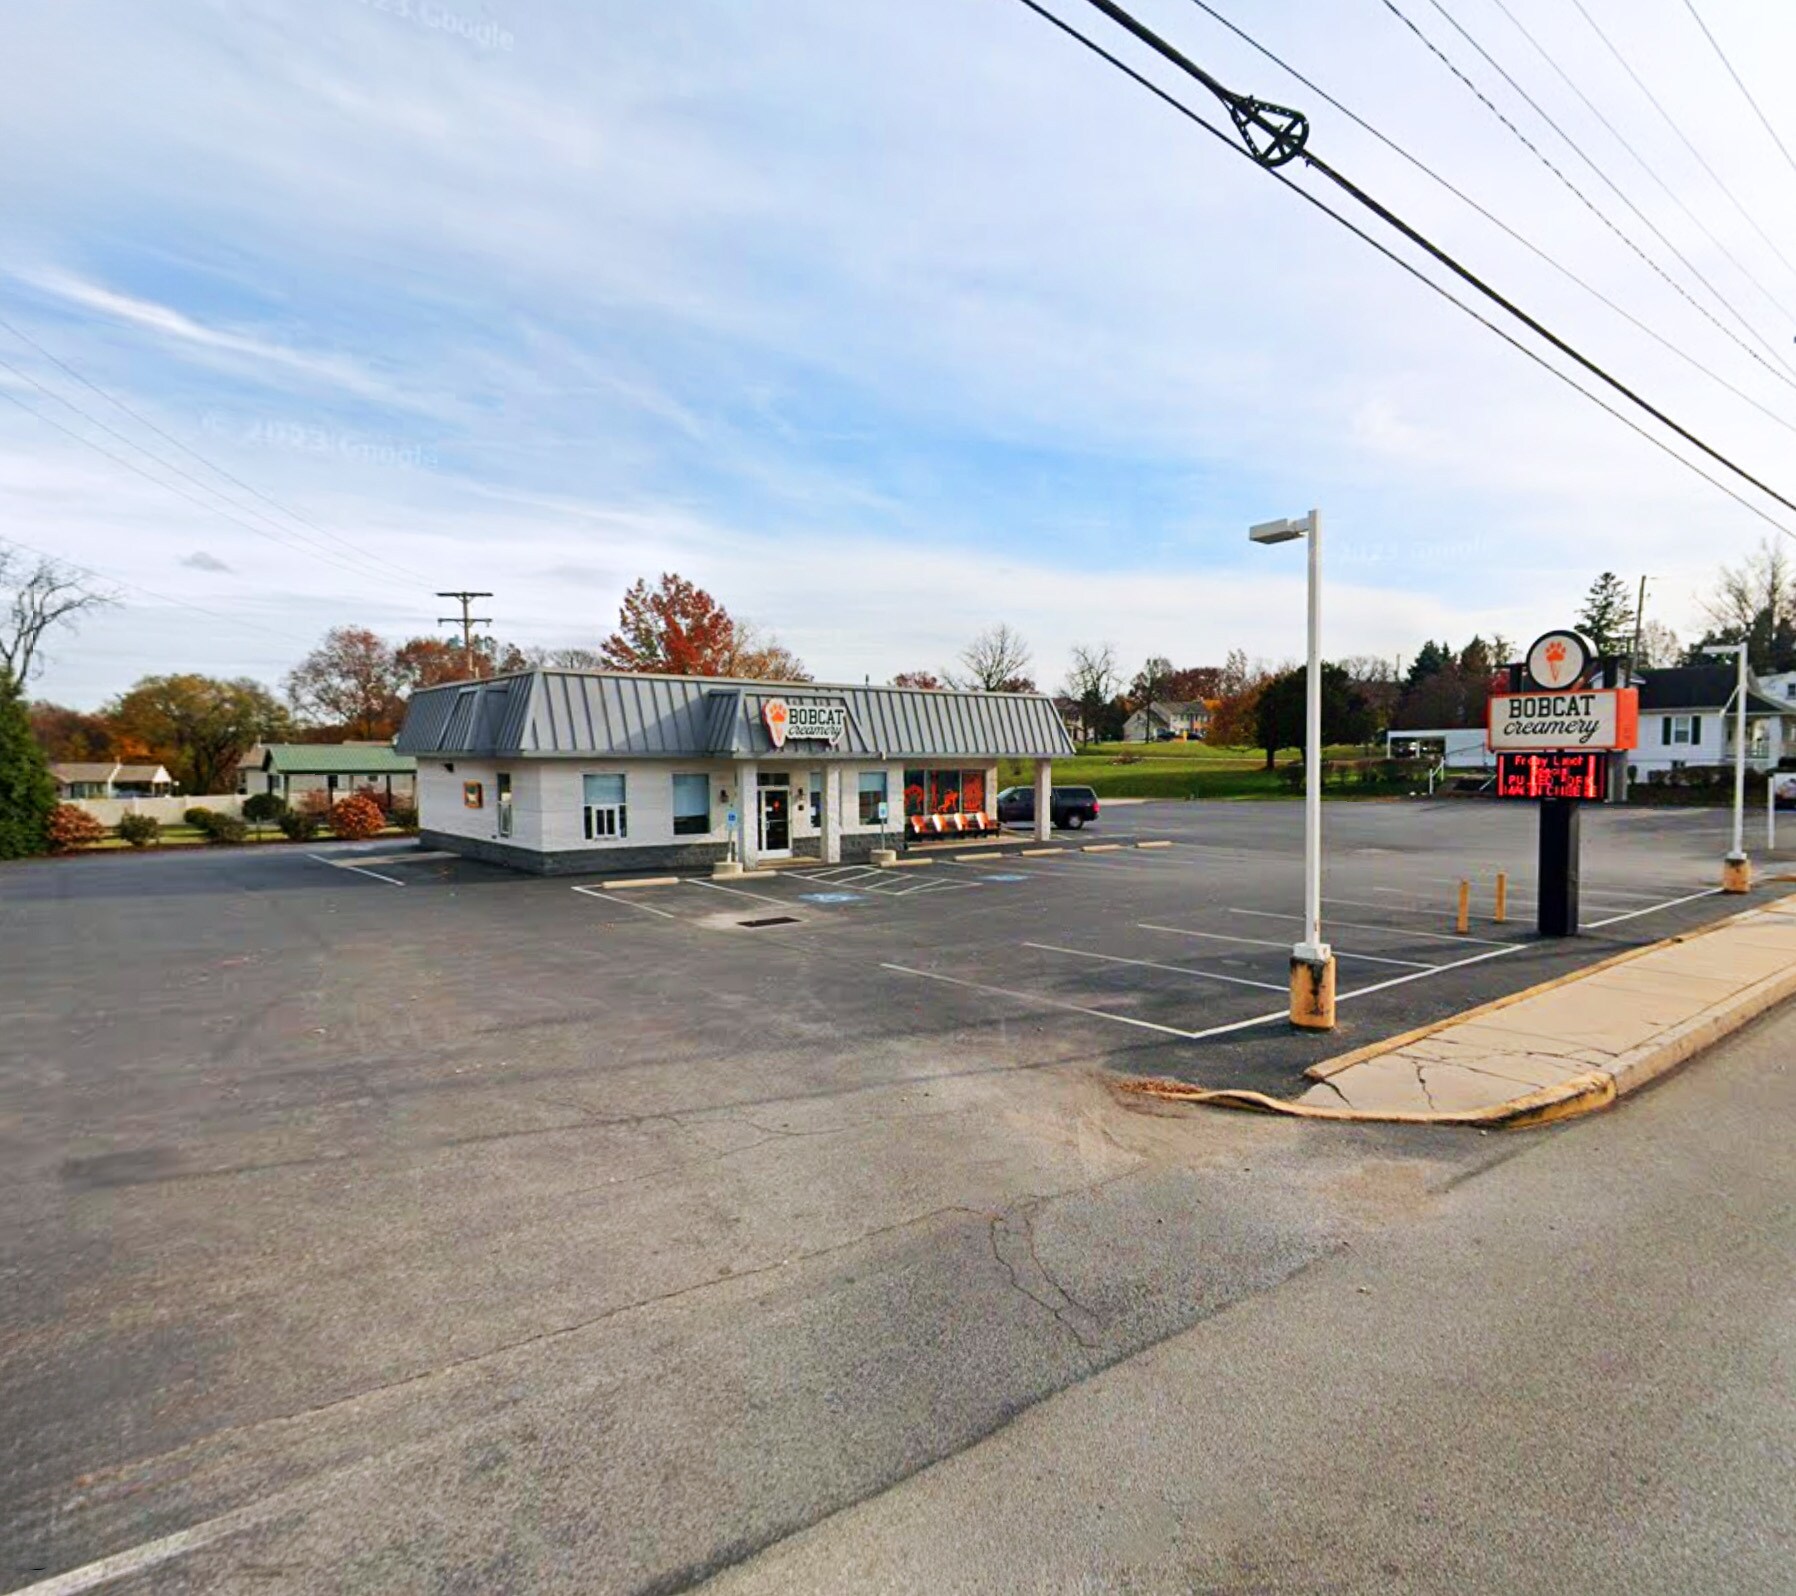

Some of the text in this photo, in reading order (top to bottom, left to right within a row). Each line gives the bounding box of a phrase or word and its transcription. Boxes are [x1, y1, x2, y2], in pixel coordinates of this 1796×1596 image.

[1508, 694, 1596, 718] BOBCAT
[788, 708, 844, 725] BOBCAT
[788, 725, 842, 742] creamery
[1503, 718, 1600, 743] creamery
